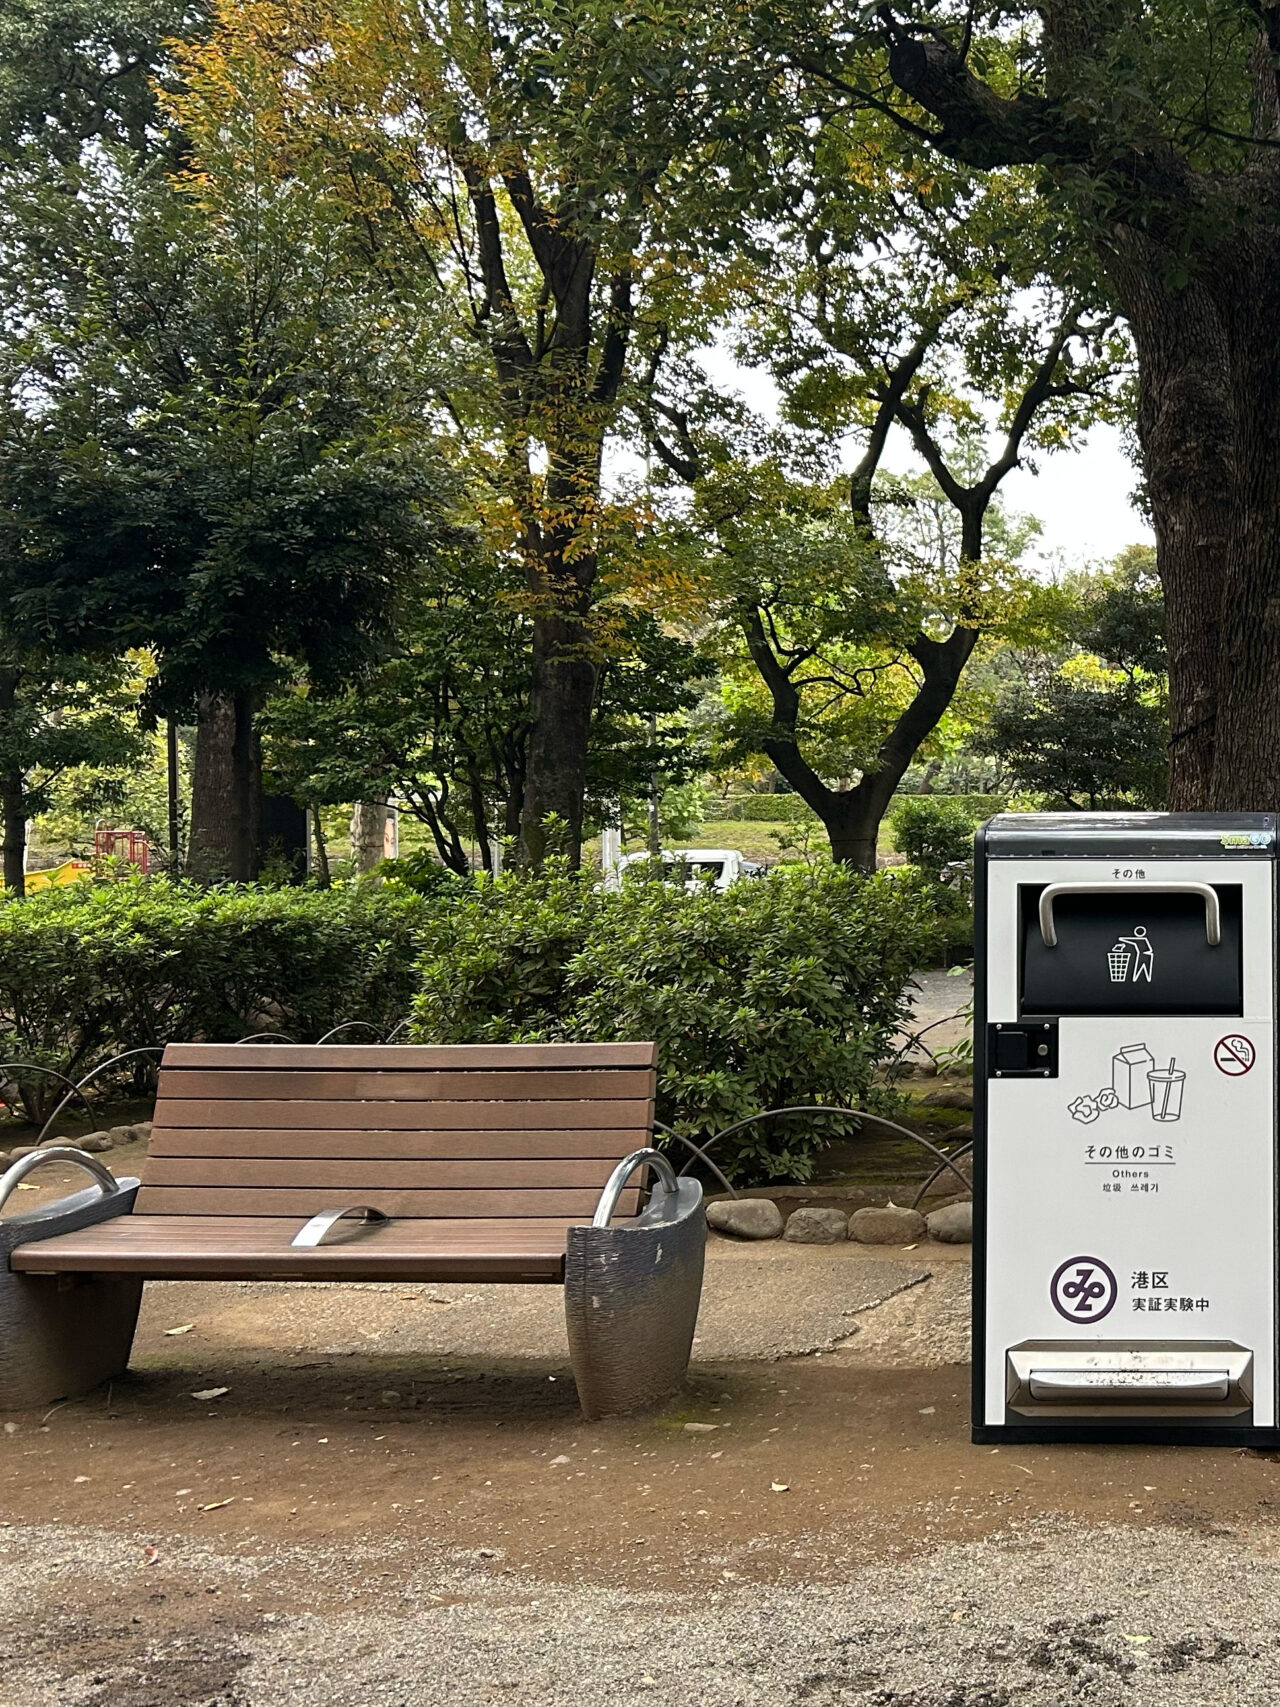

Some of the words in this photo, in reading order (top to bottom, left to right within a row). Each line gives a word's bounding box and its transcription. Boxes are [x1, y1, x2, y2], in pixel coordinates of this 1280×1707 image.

[1111, 868, 1146, 880] その他
[1084, 1144, 1174, 1160] その他のゴミ
[1111, 1169, 1149, 1179] Others
[1102, 1182, 1122, 1193] 垃圾
[1130, 1182, 1159, 1193] 쓰레기
[1130, 1270, 1169, 1290] 港区
[1132, 1297, 1210, 1313] 実証実験中
